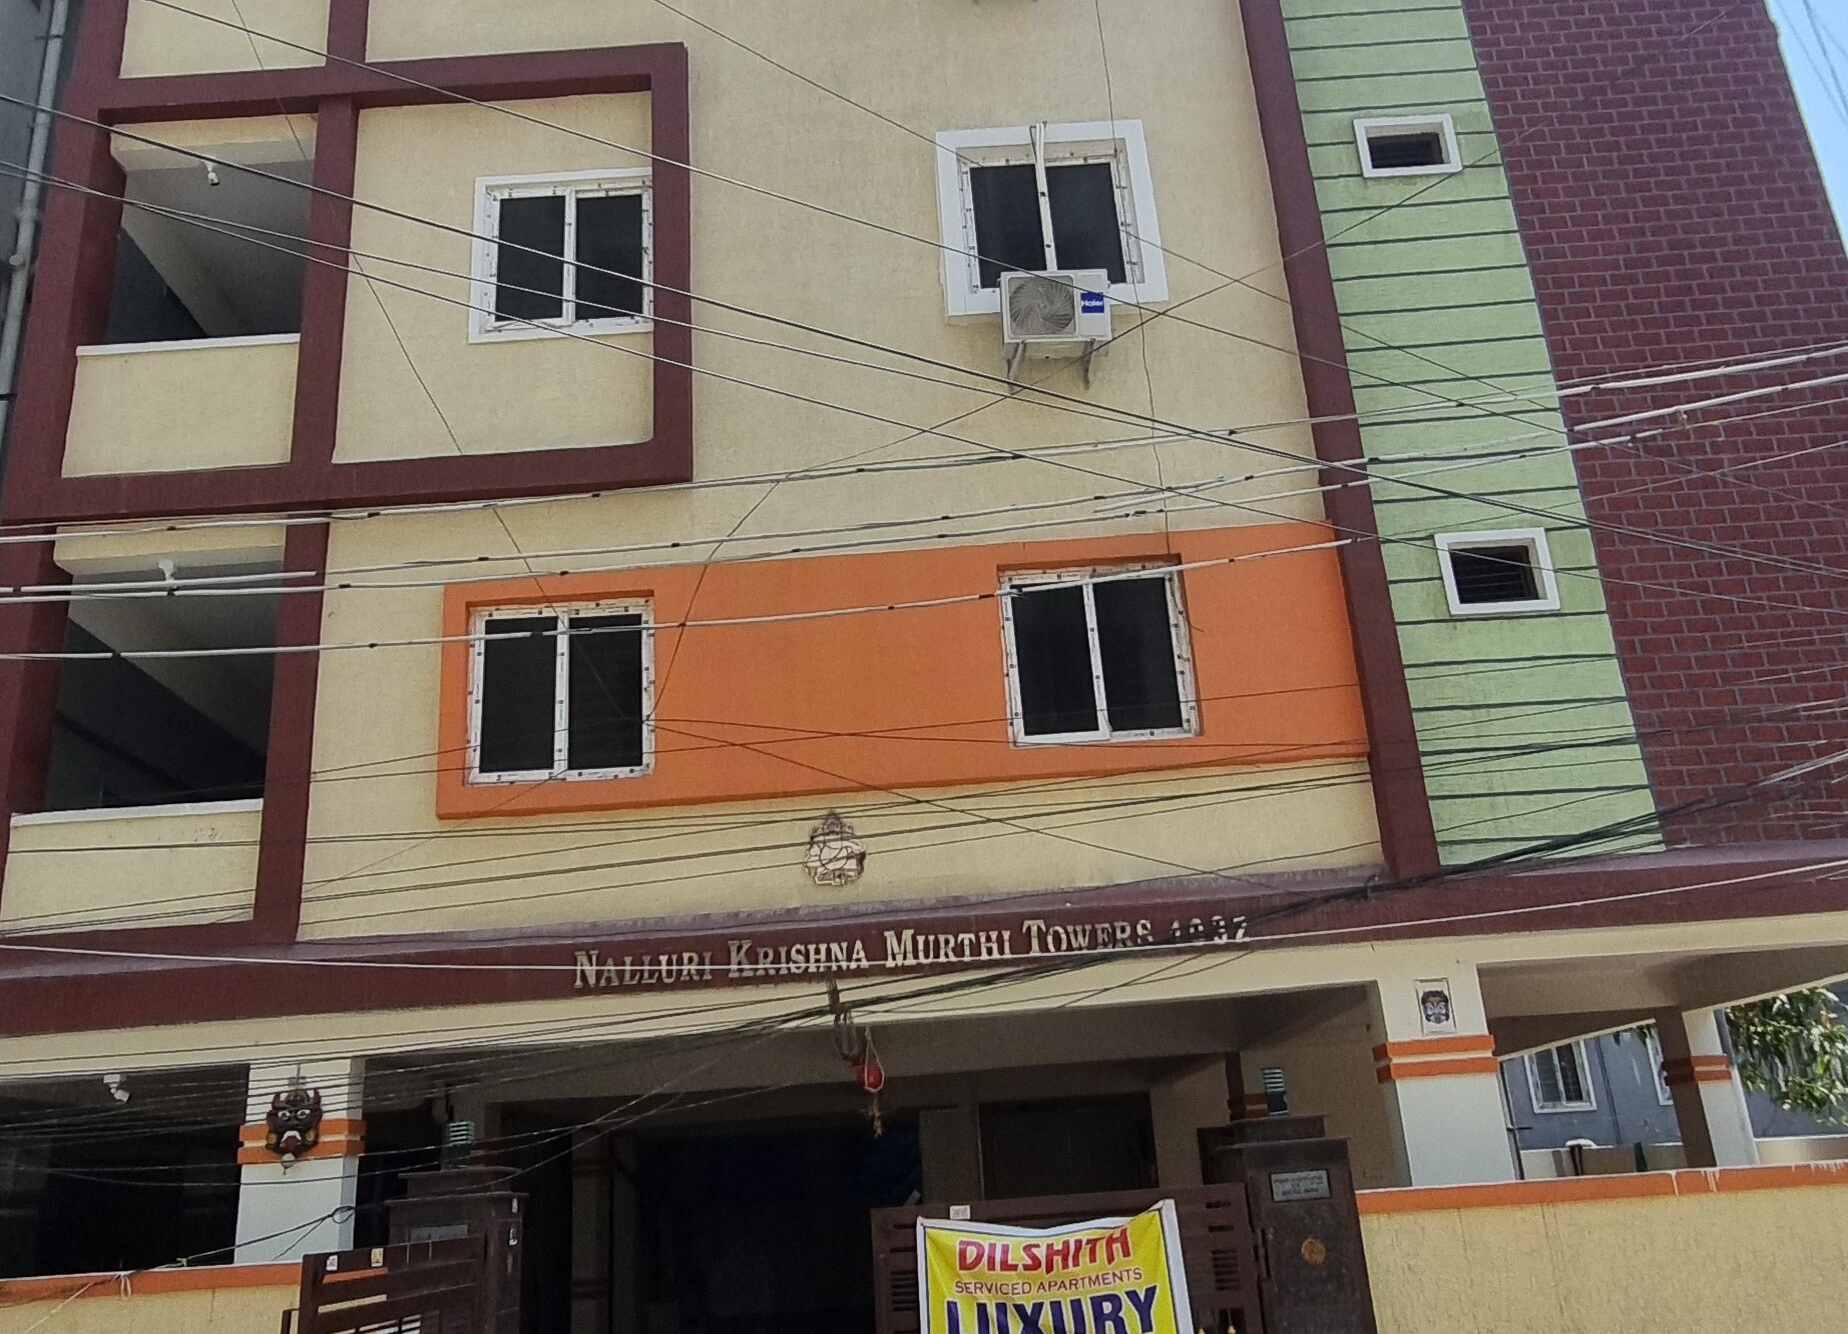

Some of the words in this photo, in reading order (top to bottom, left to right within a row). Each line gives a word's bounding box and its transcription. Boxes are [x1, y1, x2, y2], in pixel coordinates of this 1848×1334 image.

[574, 949, 713, 988] NALLURI
[727, 939, 869, 978] KRISHNA
[884, 928, 1014, 968] MURTHI
[1022, 919, 1154, 956] TOWERS
[957, 1227, 1132, 1275] DILSHITH
[955, 1280, 1032, 1296] SERVICED
[1036, 1267, 1143, 1294] APARTMENTS
